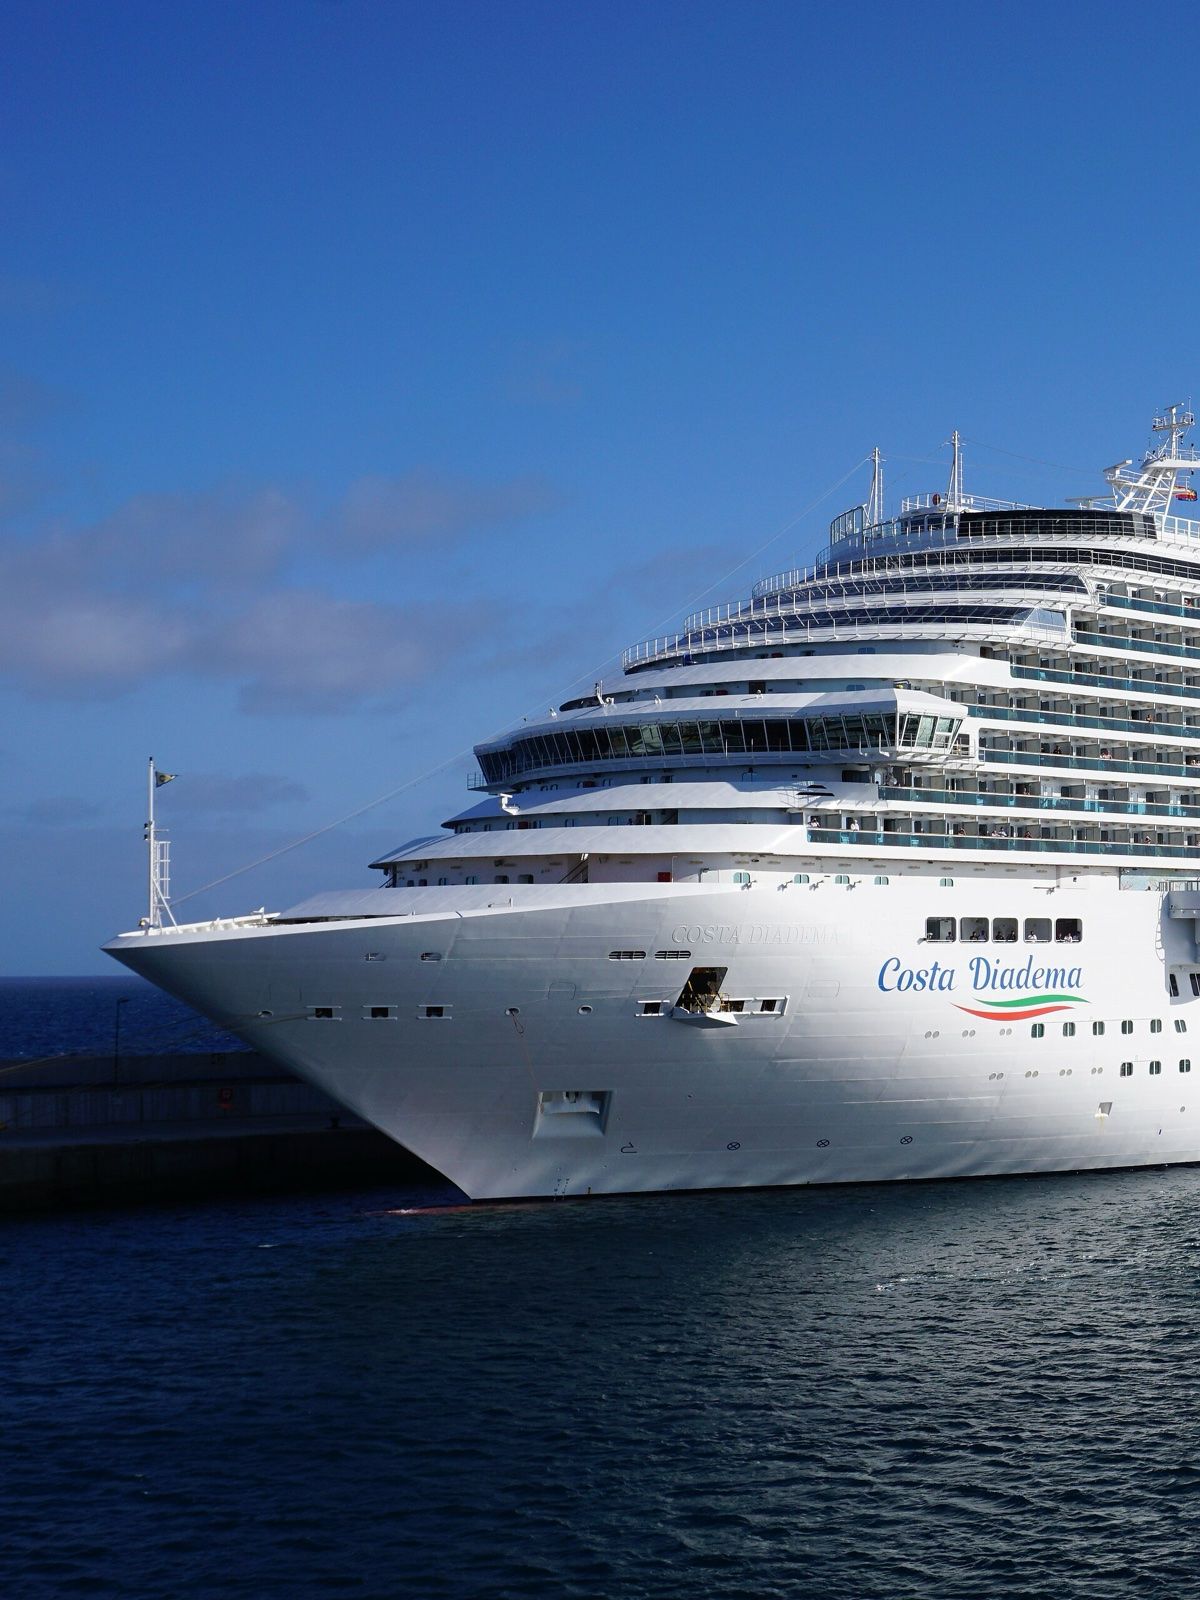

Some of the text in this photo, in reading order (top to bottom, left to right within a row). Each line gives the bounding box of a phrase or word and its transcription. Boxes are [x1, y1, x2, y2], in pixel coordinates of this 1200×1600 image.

[671, 925, 840, 945] COSTA DIADEMA
[878, 955, 1085, 992] Costa Diadema
